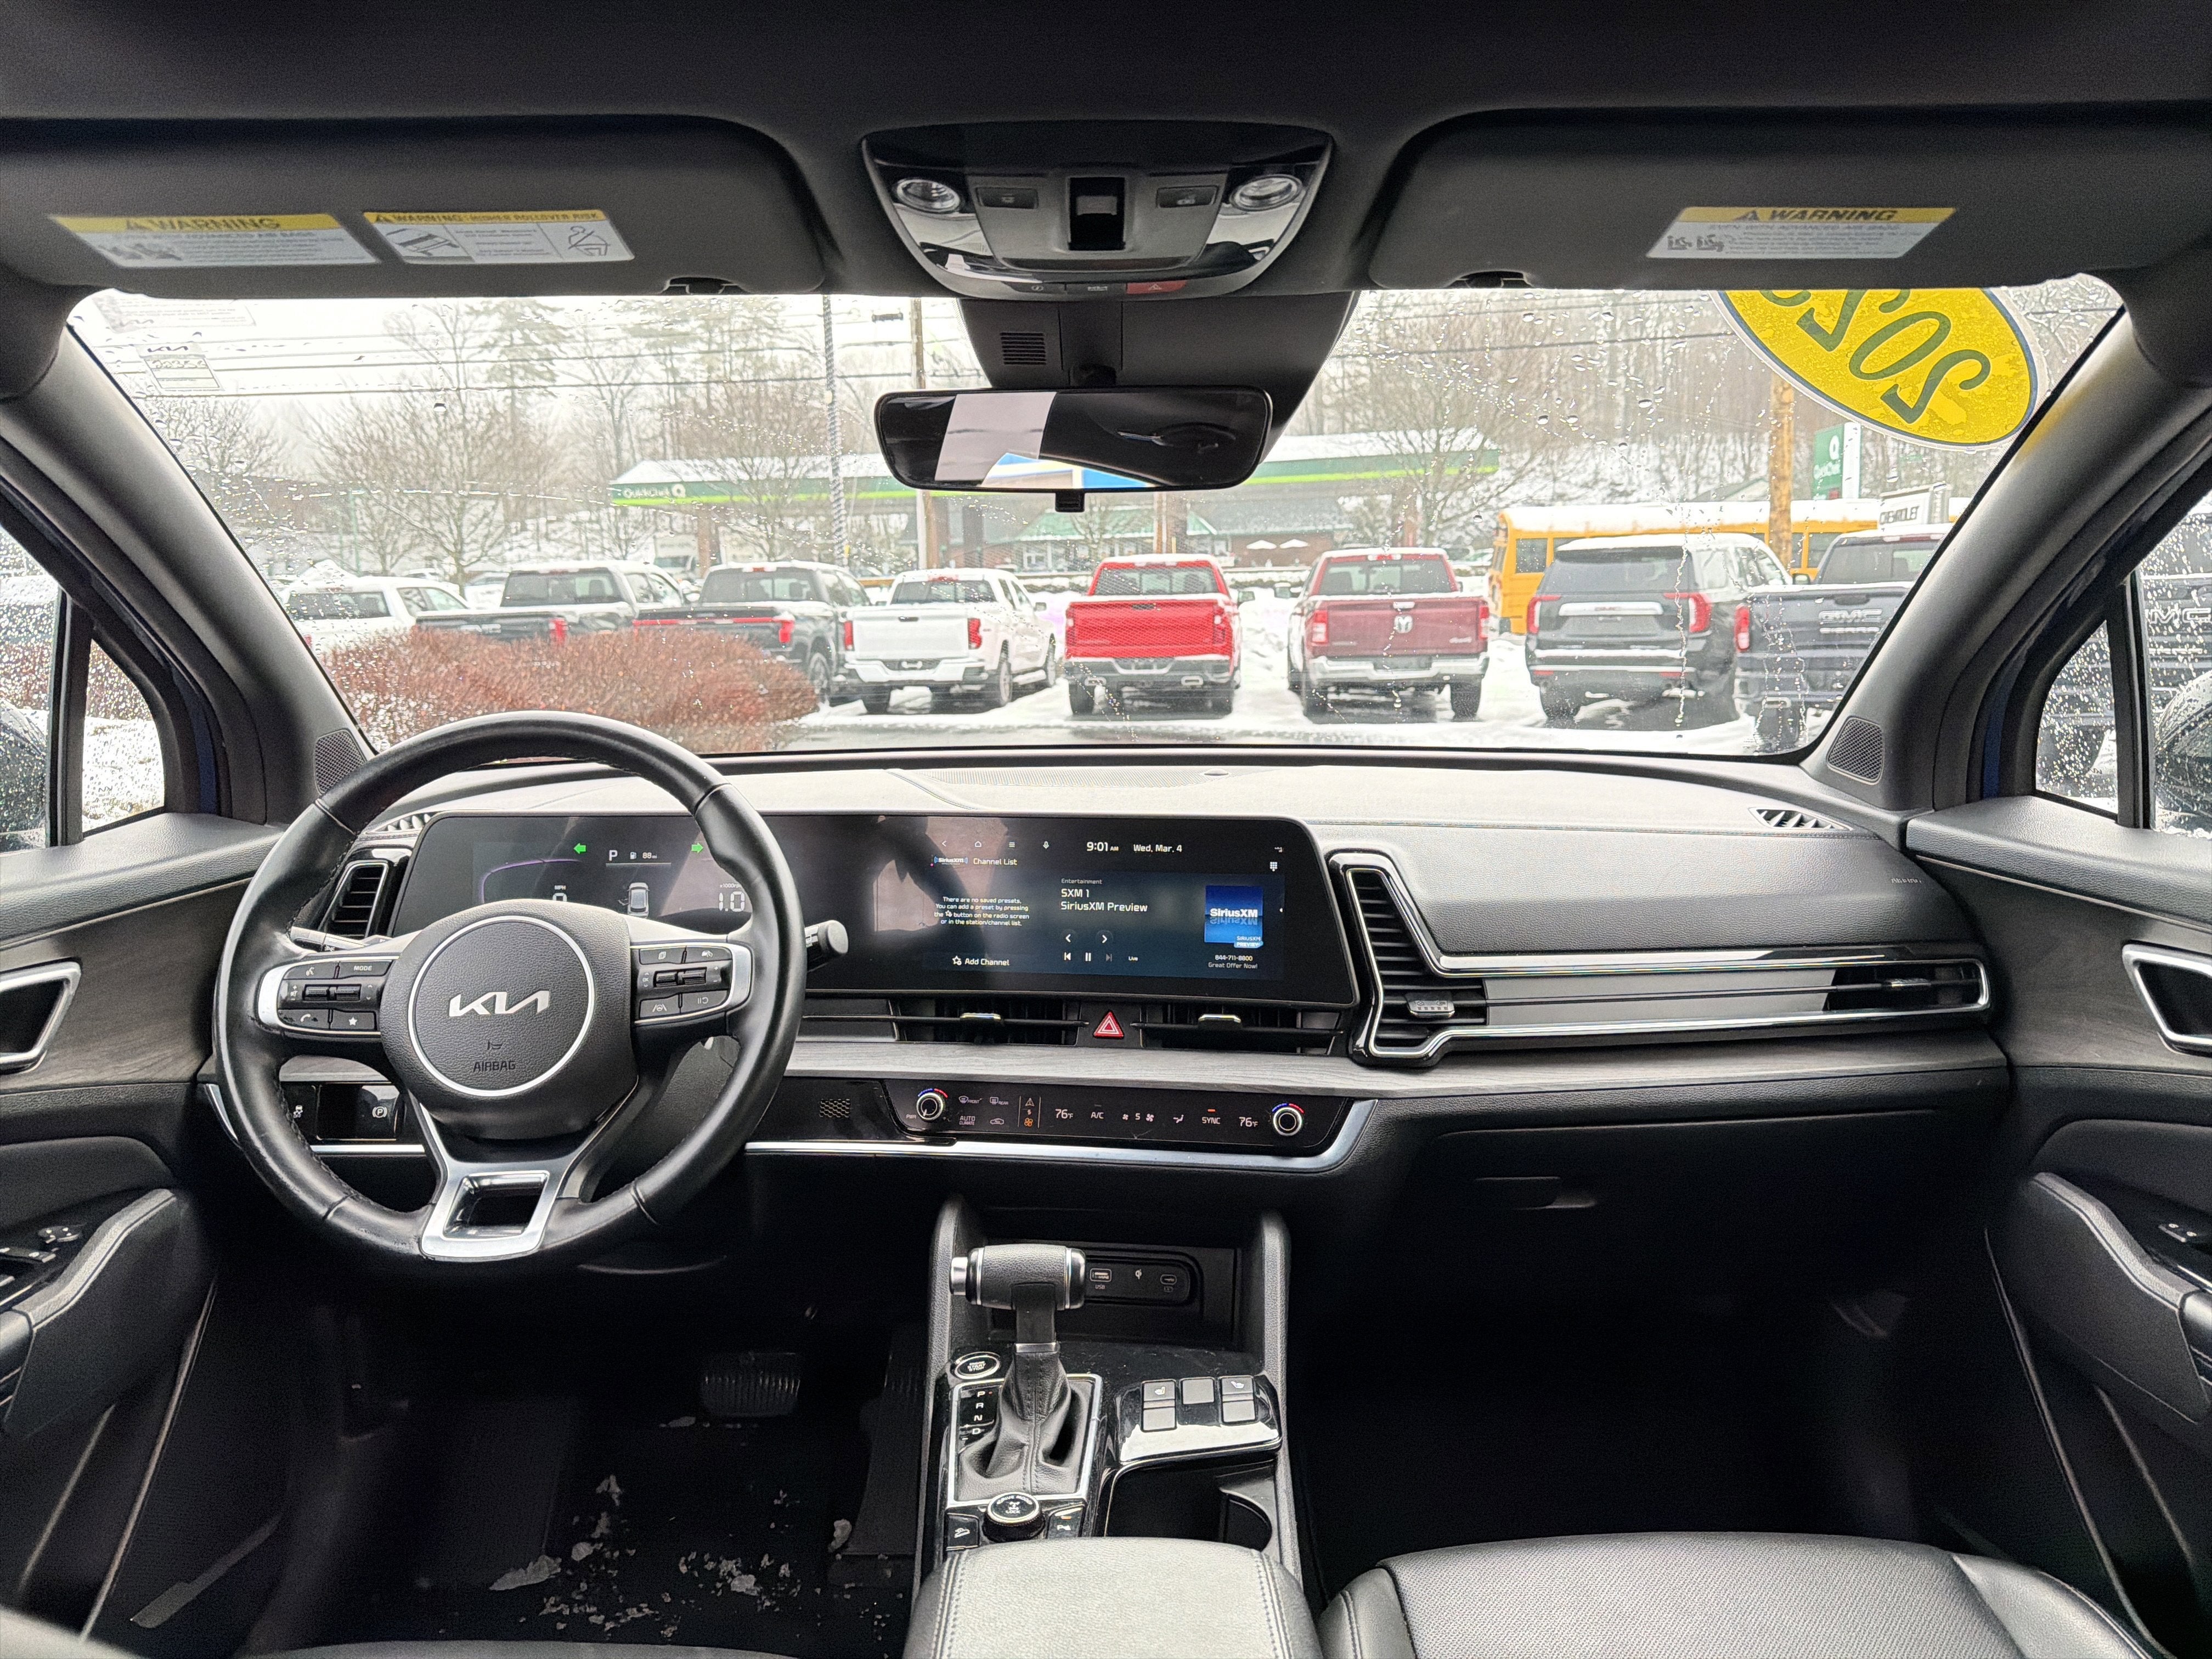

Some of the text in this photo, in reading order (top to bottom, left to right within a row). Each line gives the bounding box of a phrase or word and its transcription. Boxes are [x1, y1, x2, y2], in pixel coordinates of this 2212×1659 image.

[1769, 210, 1898, 221] WARNING
[149, 218, 281, 230] WARNING
[1818, 608, 1883, 624] GMC
[1086, 842, 1109, 851] 9:01
[1155, 844, 1175, 853] Mar.
[1176, 844, 1183, 853] 4
[608, 850, 618, 861] P
[973, 857, 1002, 866] Channel
[1060, 888, 1090, 898] SXM 1
[719, 890, 745, 912] 1.0
[1060, 901, 1148, 912] SiriusXM Preview
[1210, 908, 1259, 918] SiriusXM
[449, 990, 550, 1017] KIA
[472, 1060, 516, 1072] AIRBAG
[1091, 1111, 1105, 1120] A/C
[1201, 1116, 1221, 1125] SYNC
[996, 1495, 1033, 1505] DRIVE MODE
